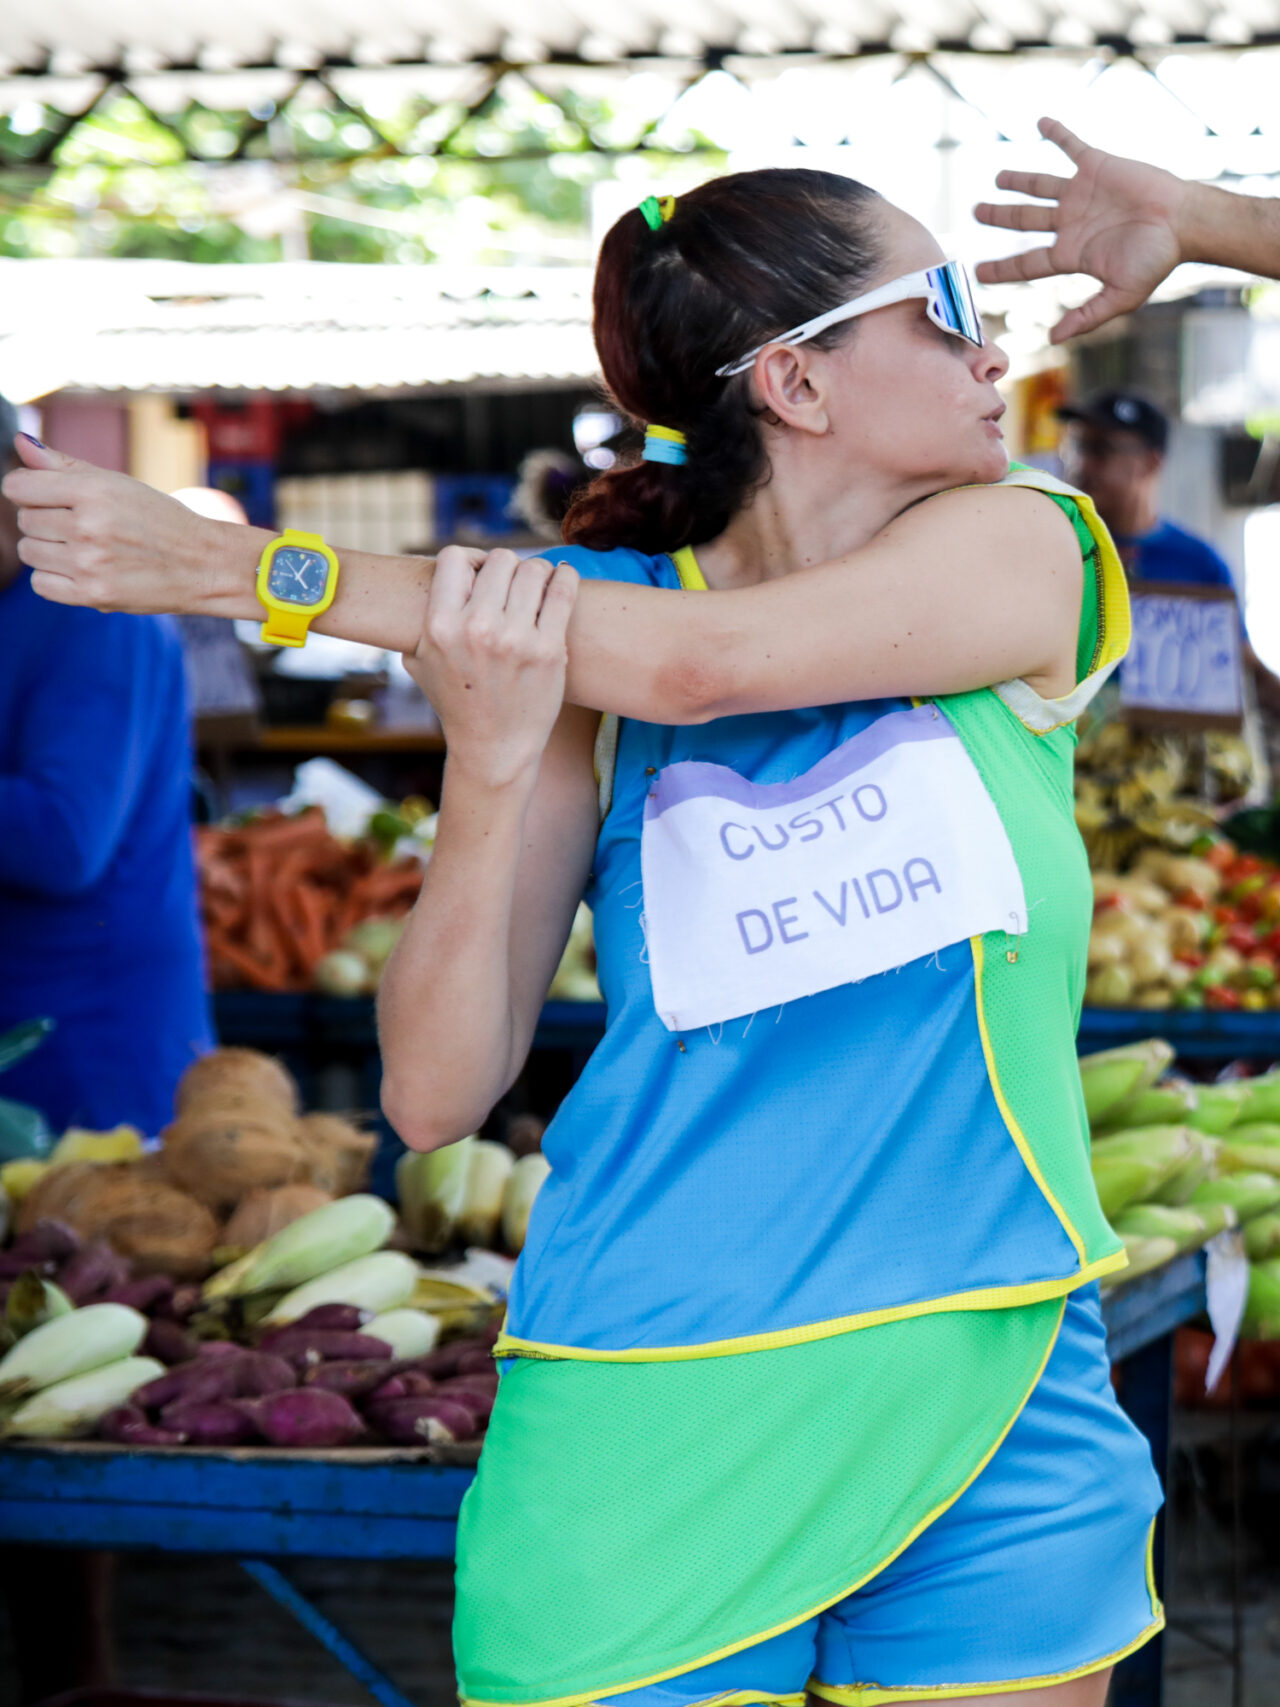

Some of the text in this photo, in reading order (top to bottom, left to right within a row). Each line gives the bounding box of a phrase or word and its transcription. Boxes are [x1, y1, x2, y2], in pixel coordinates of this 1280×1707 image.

[719, 783, 888, 861] CUSTO
[735, 856, 942, 955] DE VIDA
